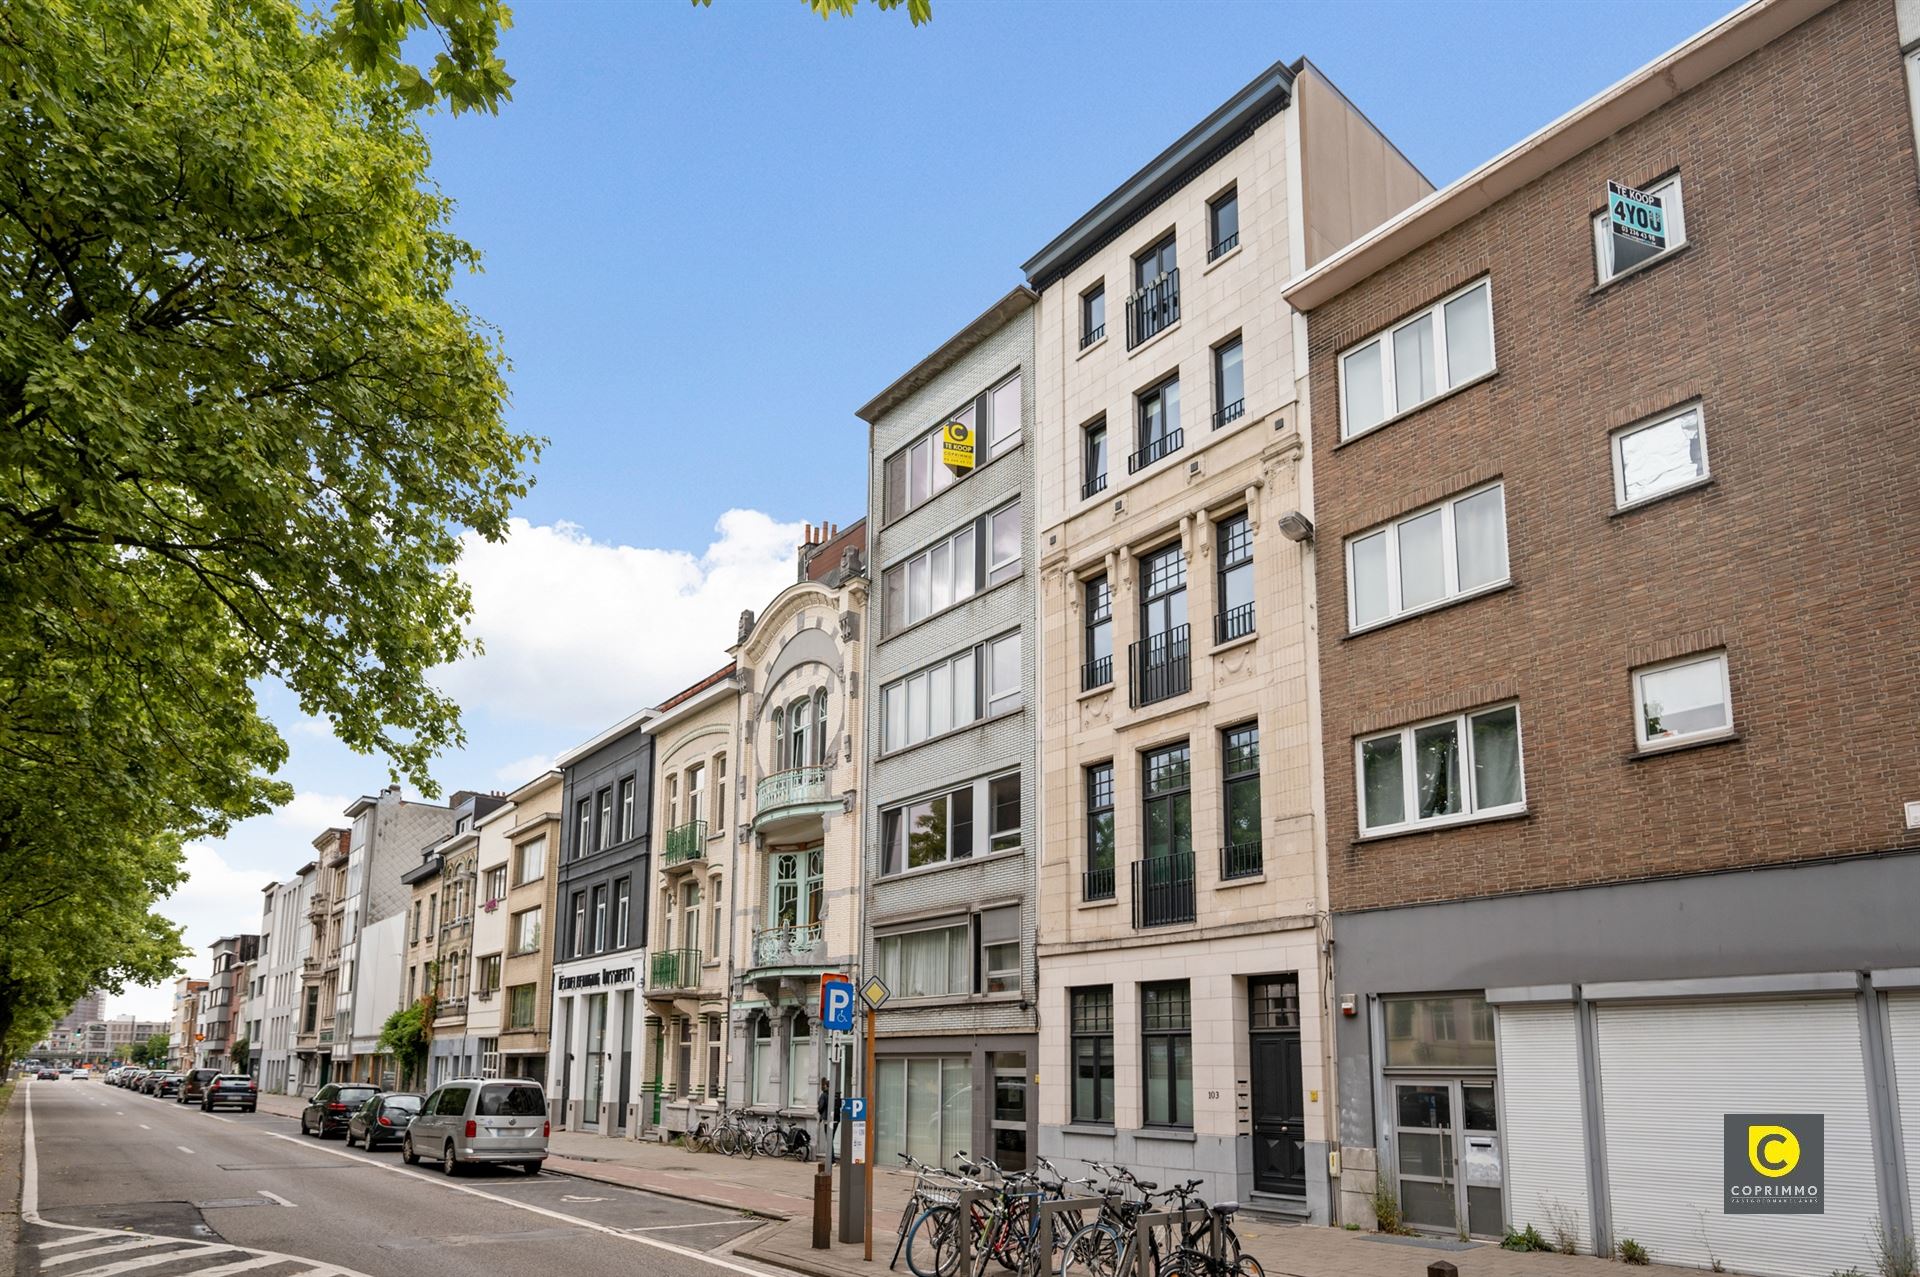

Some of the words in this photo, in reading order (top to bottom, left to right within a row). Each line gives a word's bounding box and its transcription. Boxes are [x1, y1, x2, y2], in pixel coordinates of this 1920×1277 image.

[1616, 184, 1627, 197] TE
[1629, 189, 1654, 205] KOOP
[1615, 200, 1661, 232] 4YOU
[1621, 225, 1628, 233] 03
[951, 424, 964, 440] C
[953, 444, 972, 452] KOOP
[829, 989, 849, 1022] P
[1208, 1091, 1219, 1099] 103
[852, 1100, 863, 1117] P
